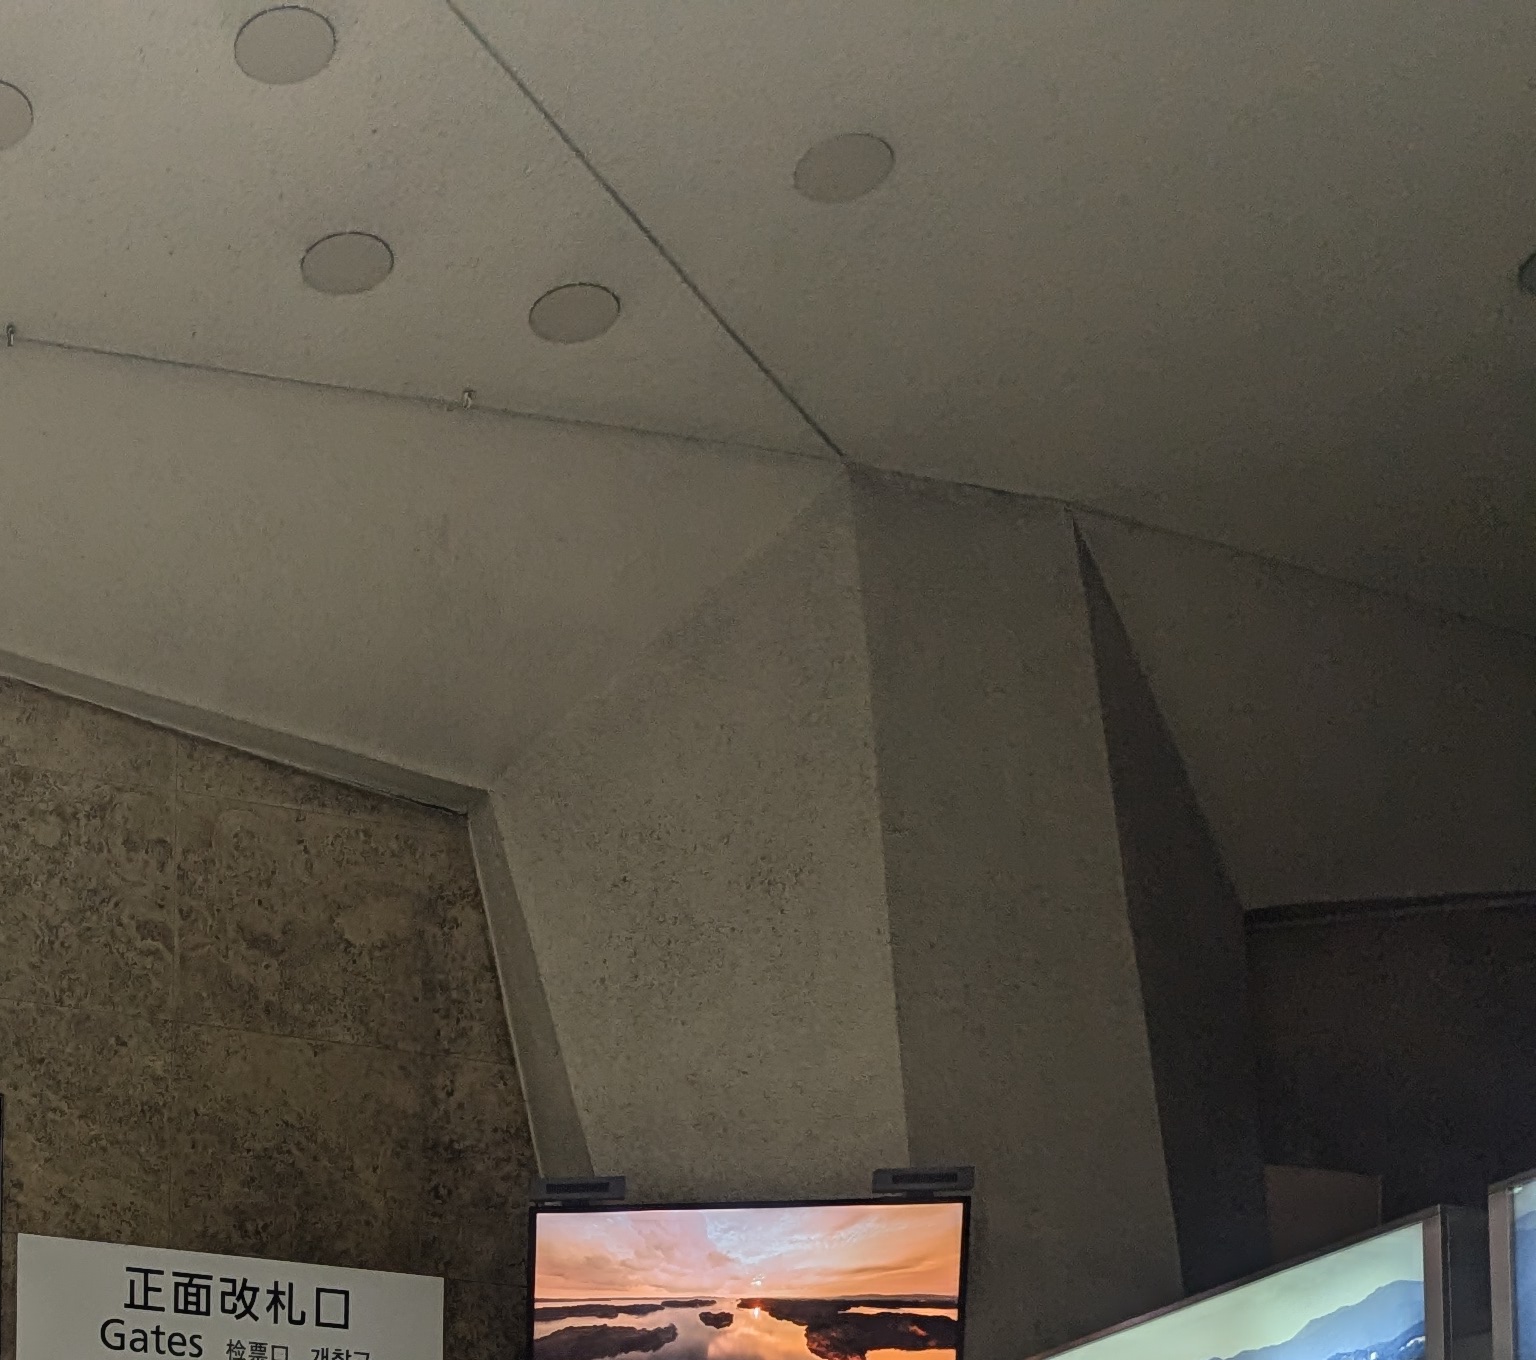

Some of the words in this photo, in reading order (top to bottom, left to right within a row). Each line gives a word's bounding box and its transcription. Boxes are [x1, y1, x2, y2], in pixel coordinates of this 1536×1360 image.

[124, 1266, 349, 1330] 正面改札口
[100, 1319, 203, 1359] Gates
